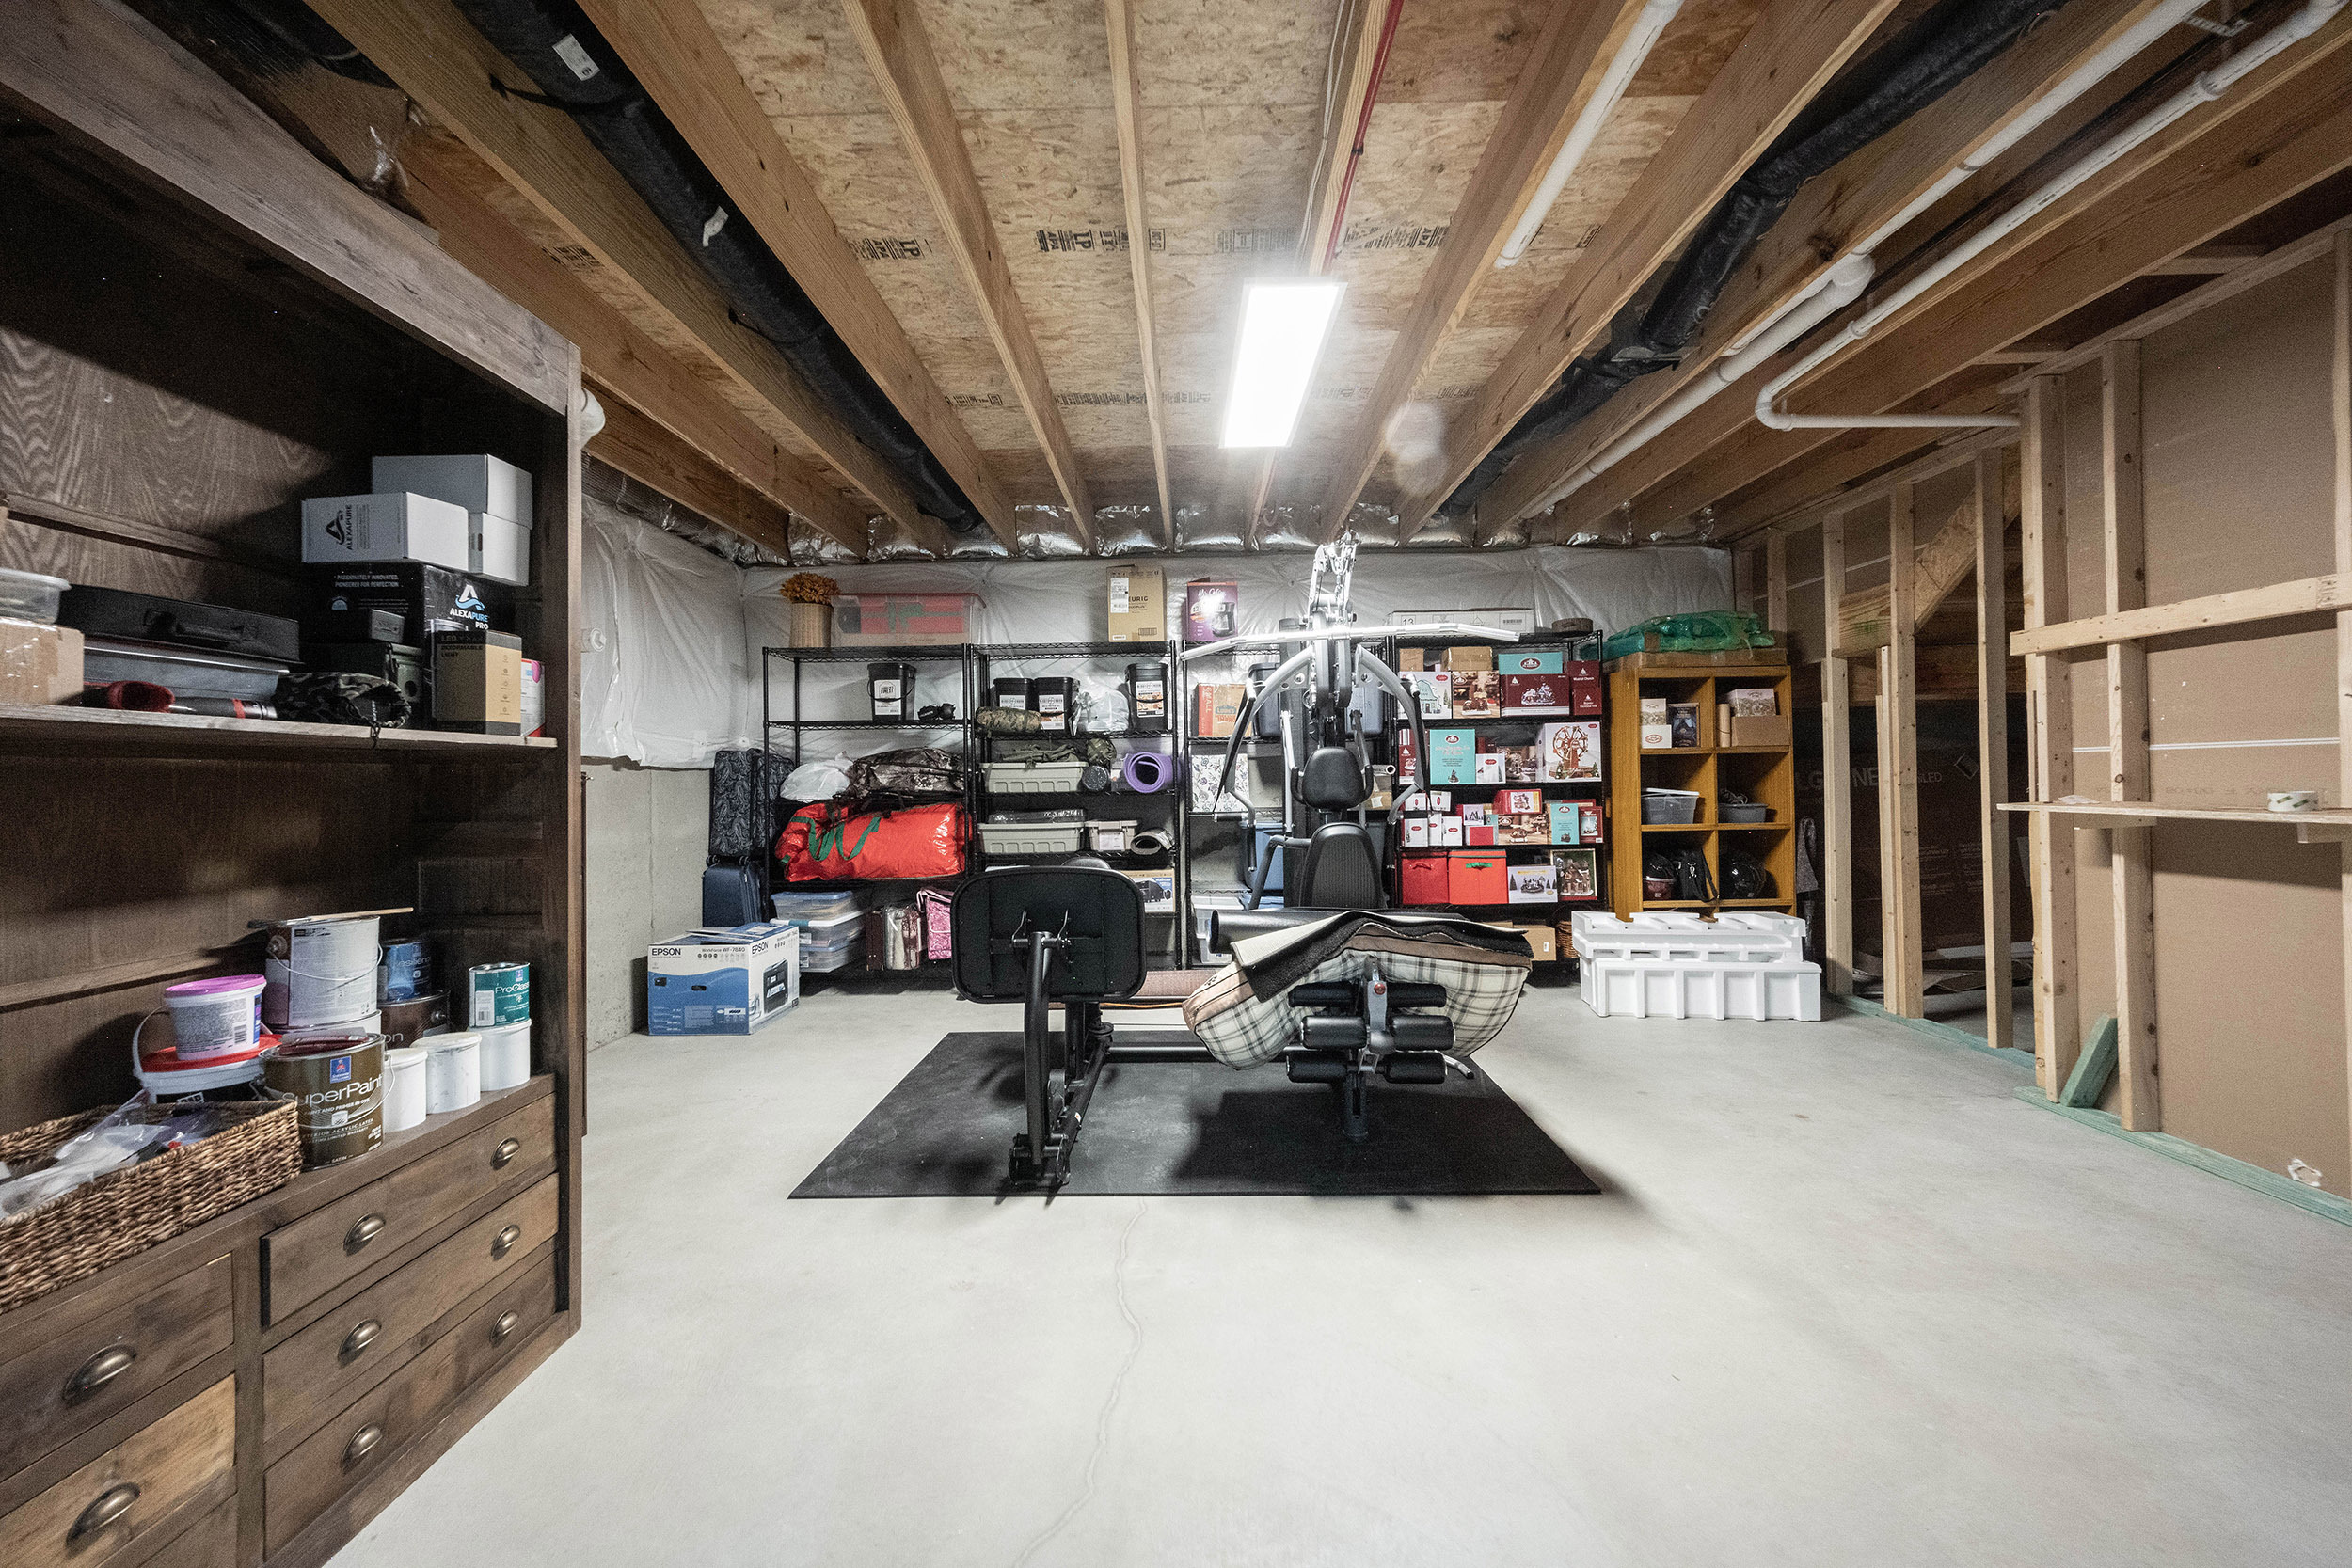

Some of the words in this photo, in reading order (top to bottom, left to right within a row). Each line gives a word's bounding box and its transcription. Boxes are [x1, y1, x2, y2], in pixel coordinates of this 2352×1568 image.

[899, 239, 921, 257] LP
[1073, 231, 1093, 250] LP
[450, 608, 489, 623] ALEXAPURE
[475, 621, 489, 630] PRO
[651, 947, 681, 956] EPSON
[752, 941, 770, 955] EPSON
[282, 1073, 383, 1108] SuperPaint
[332, 1122, 358, 1134] ACRYLIC
[358, 1117, 373, 1127] LATEX
